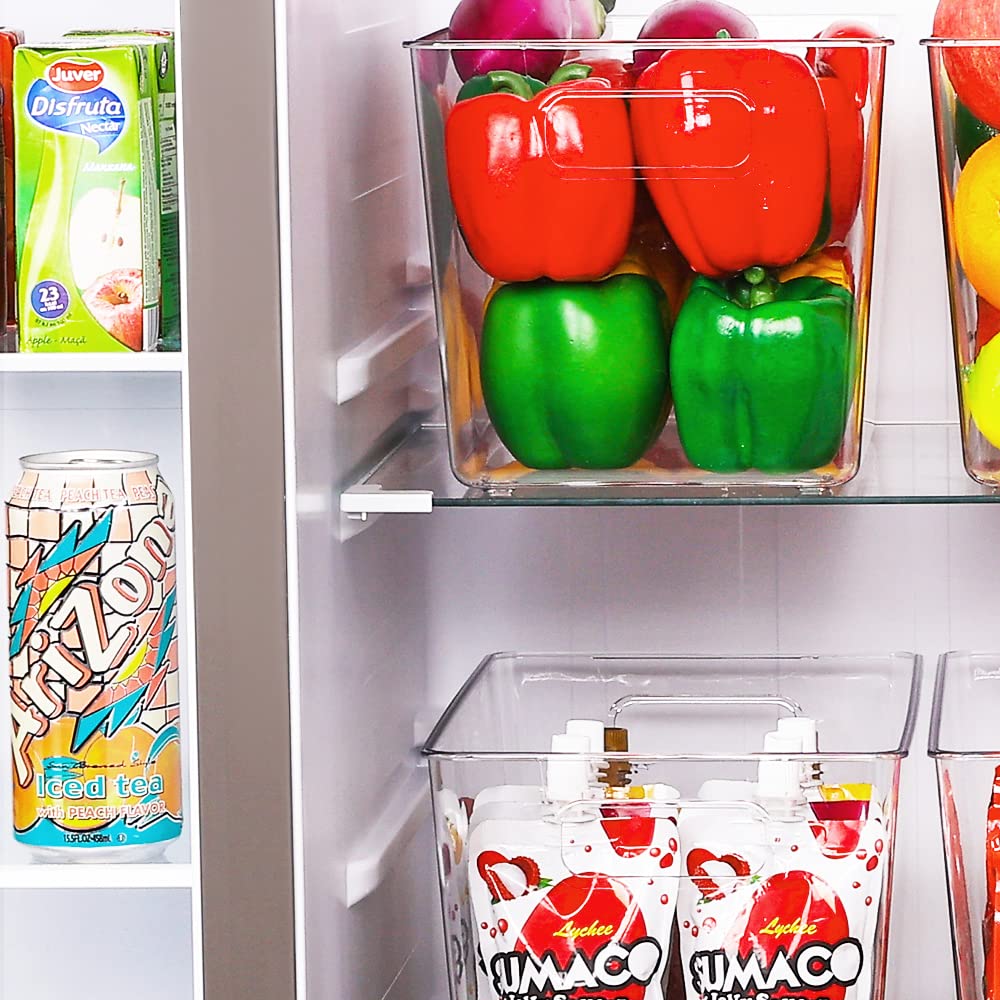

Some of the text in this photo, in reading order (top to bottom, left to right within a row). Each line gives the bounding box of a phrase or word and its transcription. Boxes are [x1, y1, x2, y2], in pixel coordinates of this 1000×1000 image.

[51, 66, 102, 82] Juver
[30, 95, 122, 117] Disfruta
[39, 286, 60, 303] 23
[62, 488, 99, 501] PEACH
[104, 487, 125, 500] TEA
[36, 774, 164, 799] Iced tea
[38, 801, 166, 819] with PEACH FLAVOR
[553, 919, 614, 940] Lychee
[759, 917, 818, 939] Lychee
